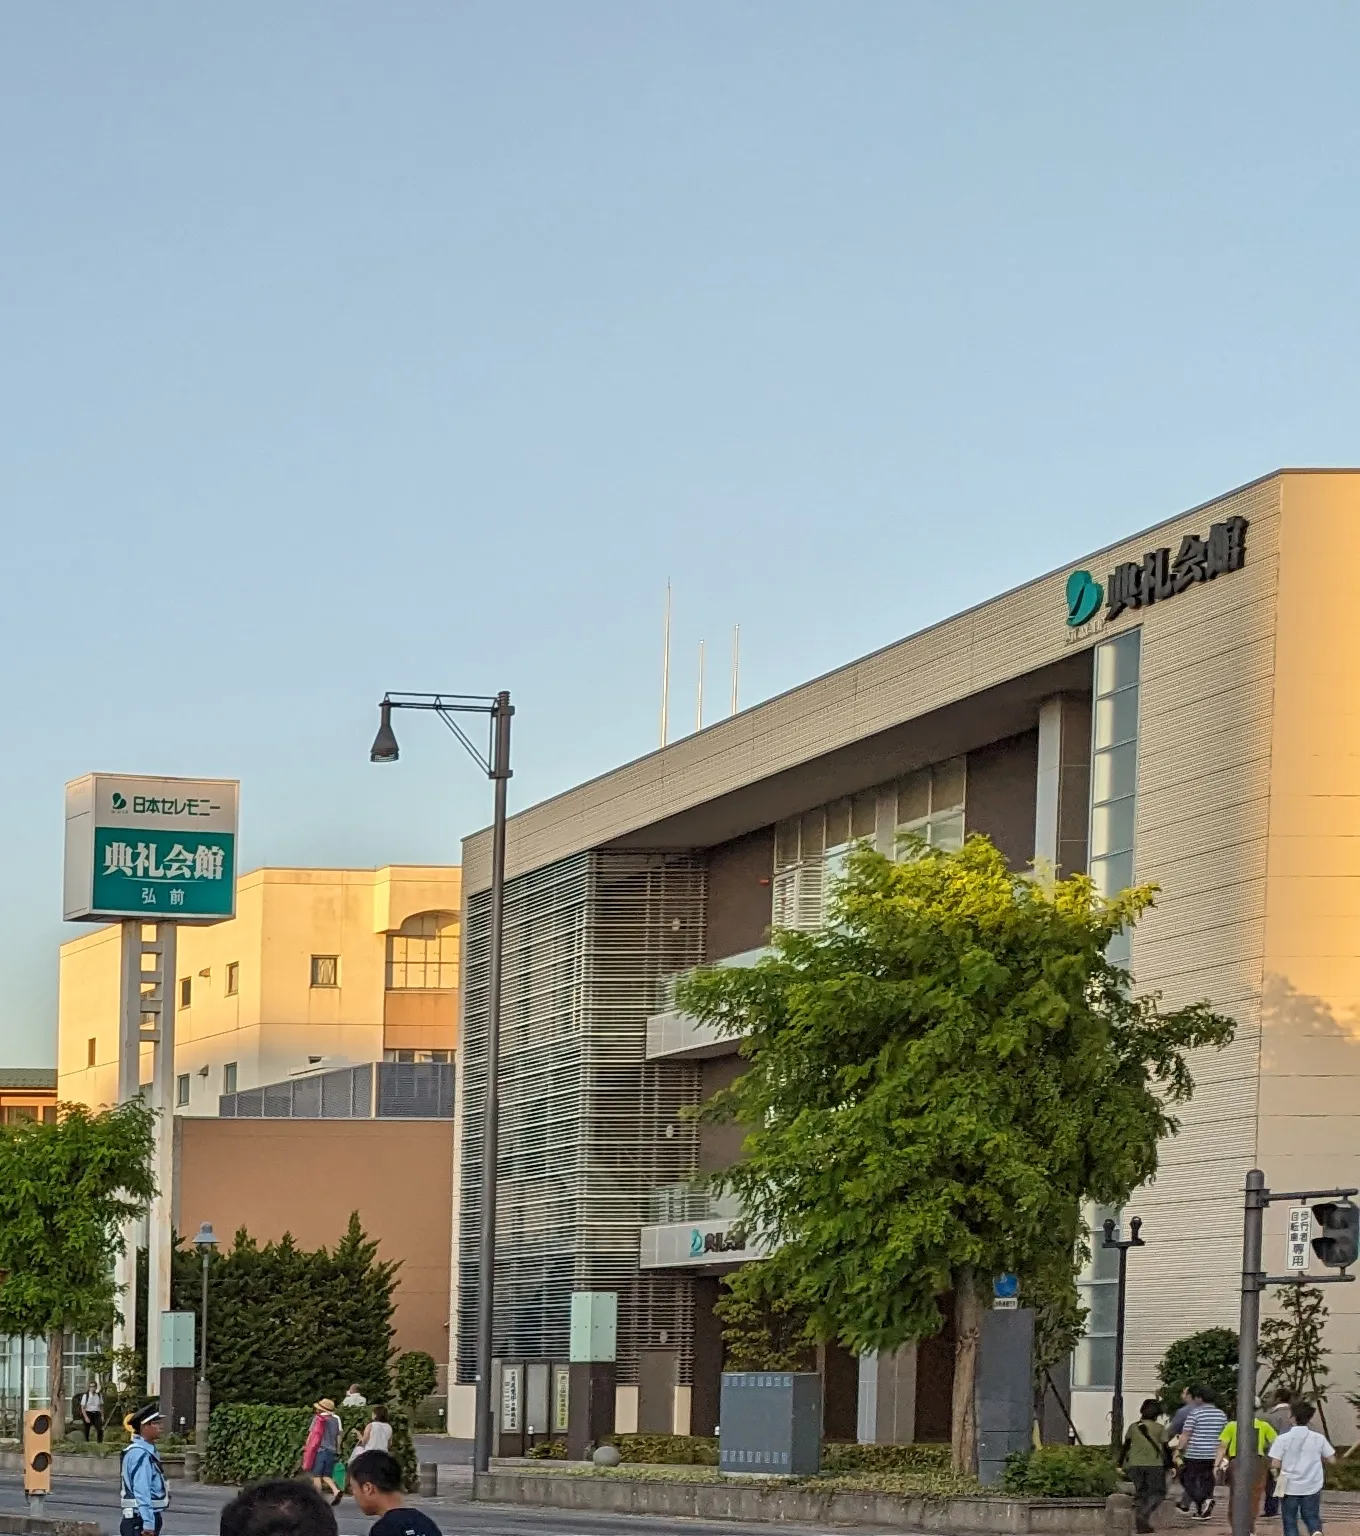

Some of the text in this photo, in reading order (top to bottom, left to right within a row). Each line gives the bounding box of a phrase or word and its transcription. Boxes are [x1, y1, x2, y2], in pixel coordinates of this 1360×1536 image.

[133, 796, 221, 816] 日本セレモニー
[102, 841, 226, 880] 典礼会館
[141, 887, 185, 906] 弘前
